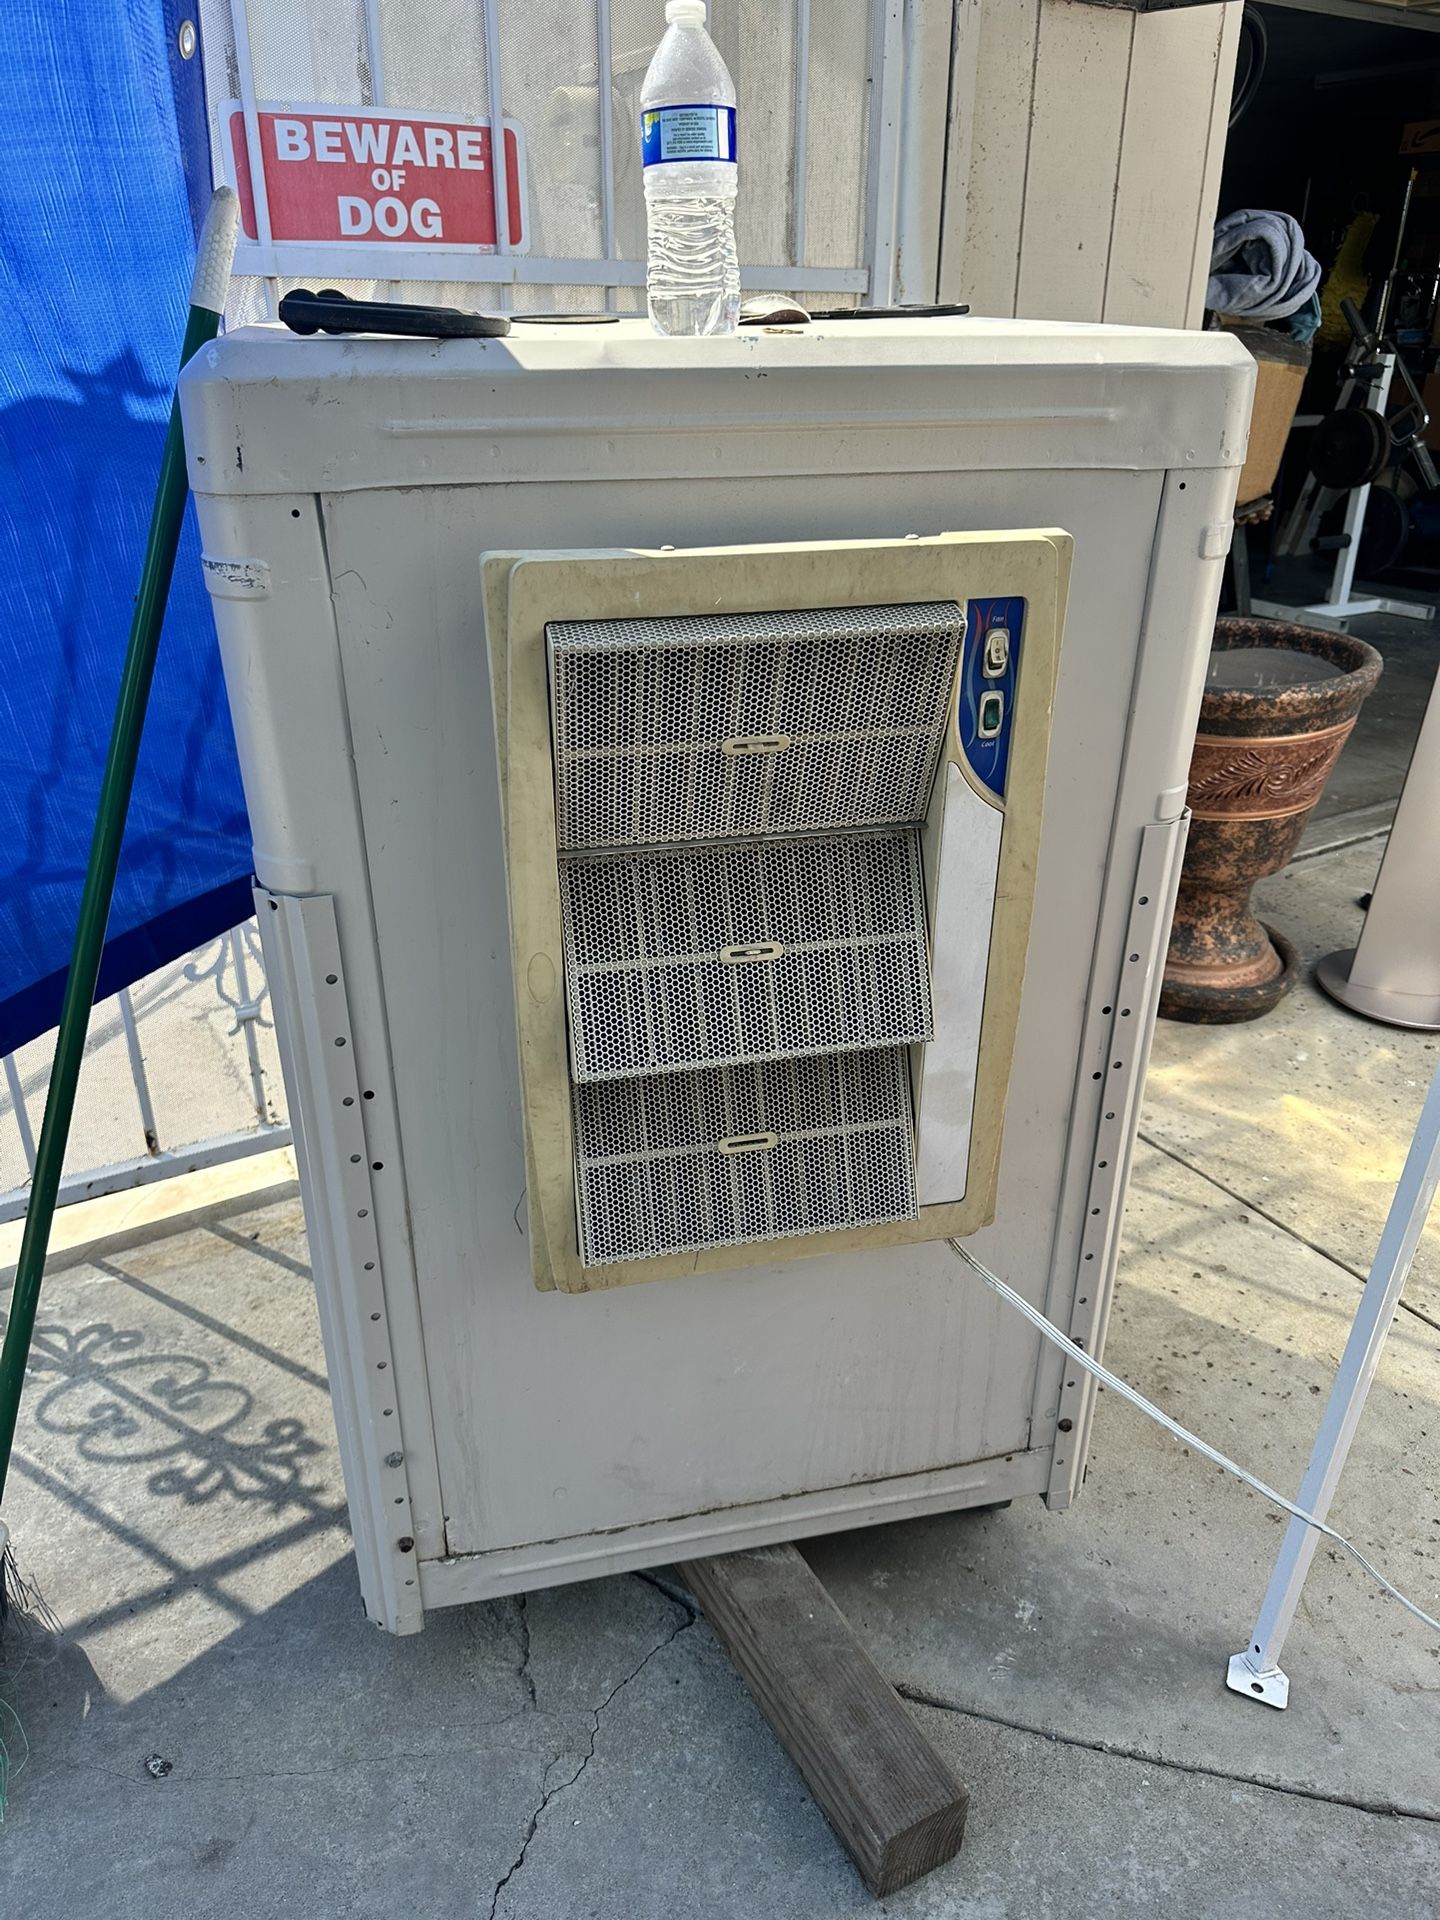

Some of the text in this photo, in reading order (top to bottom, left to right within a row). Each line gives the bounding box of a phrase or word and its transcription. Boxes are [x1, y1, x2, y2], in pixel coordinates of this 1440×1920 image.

[273, 118, 485, 171] BEWARE
[371, 168, 406, 192] OF
[337, 195, 443, 239] DOG
[991, 615, 1005, 623] Fan
[980, 740, 995, 748] Cool
